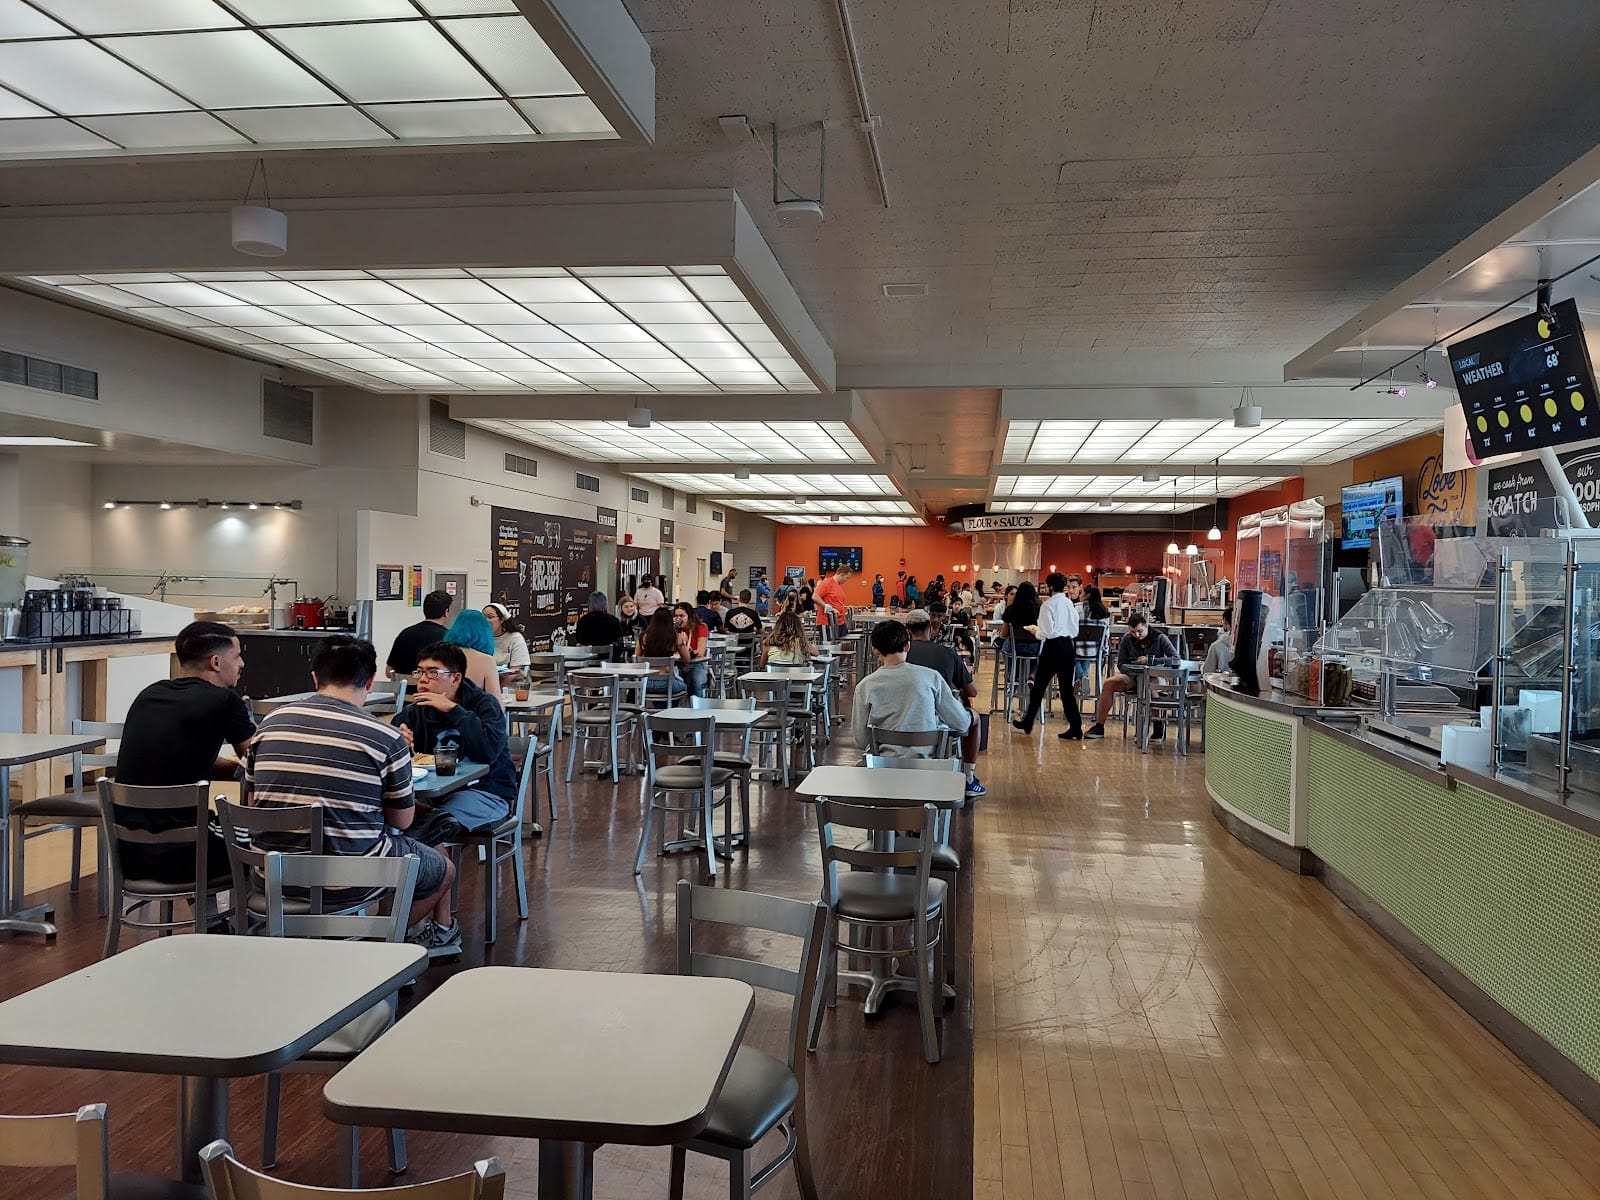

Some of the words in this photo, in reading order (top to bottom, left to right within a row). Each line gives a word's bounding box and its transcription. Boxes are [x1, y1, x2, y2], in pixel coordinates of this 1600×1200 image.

[1458, 358, 1475, 368] LOCAL
[1462, 362, 1504, 385] WEATHER
[1422, 454, 1456, 500] Love
[1577, 464, 1594, 478] our
[1493, 482, 1501, 491] we
[1502, 475, 1515, 489] cook
[1516, 473, 1535, 491] from
[1488, 490, 1538, 518] SCRATCH
[968, 519, 992, 529] FLOUR
[1000, 517, 1033, 527] SAUCE
[533, 560, 545, 574] DID
[546, 561, 560, 576] YOU
[532, 574, 559, 591] KNOW?
